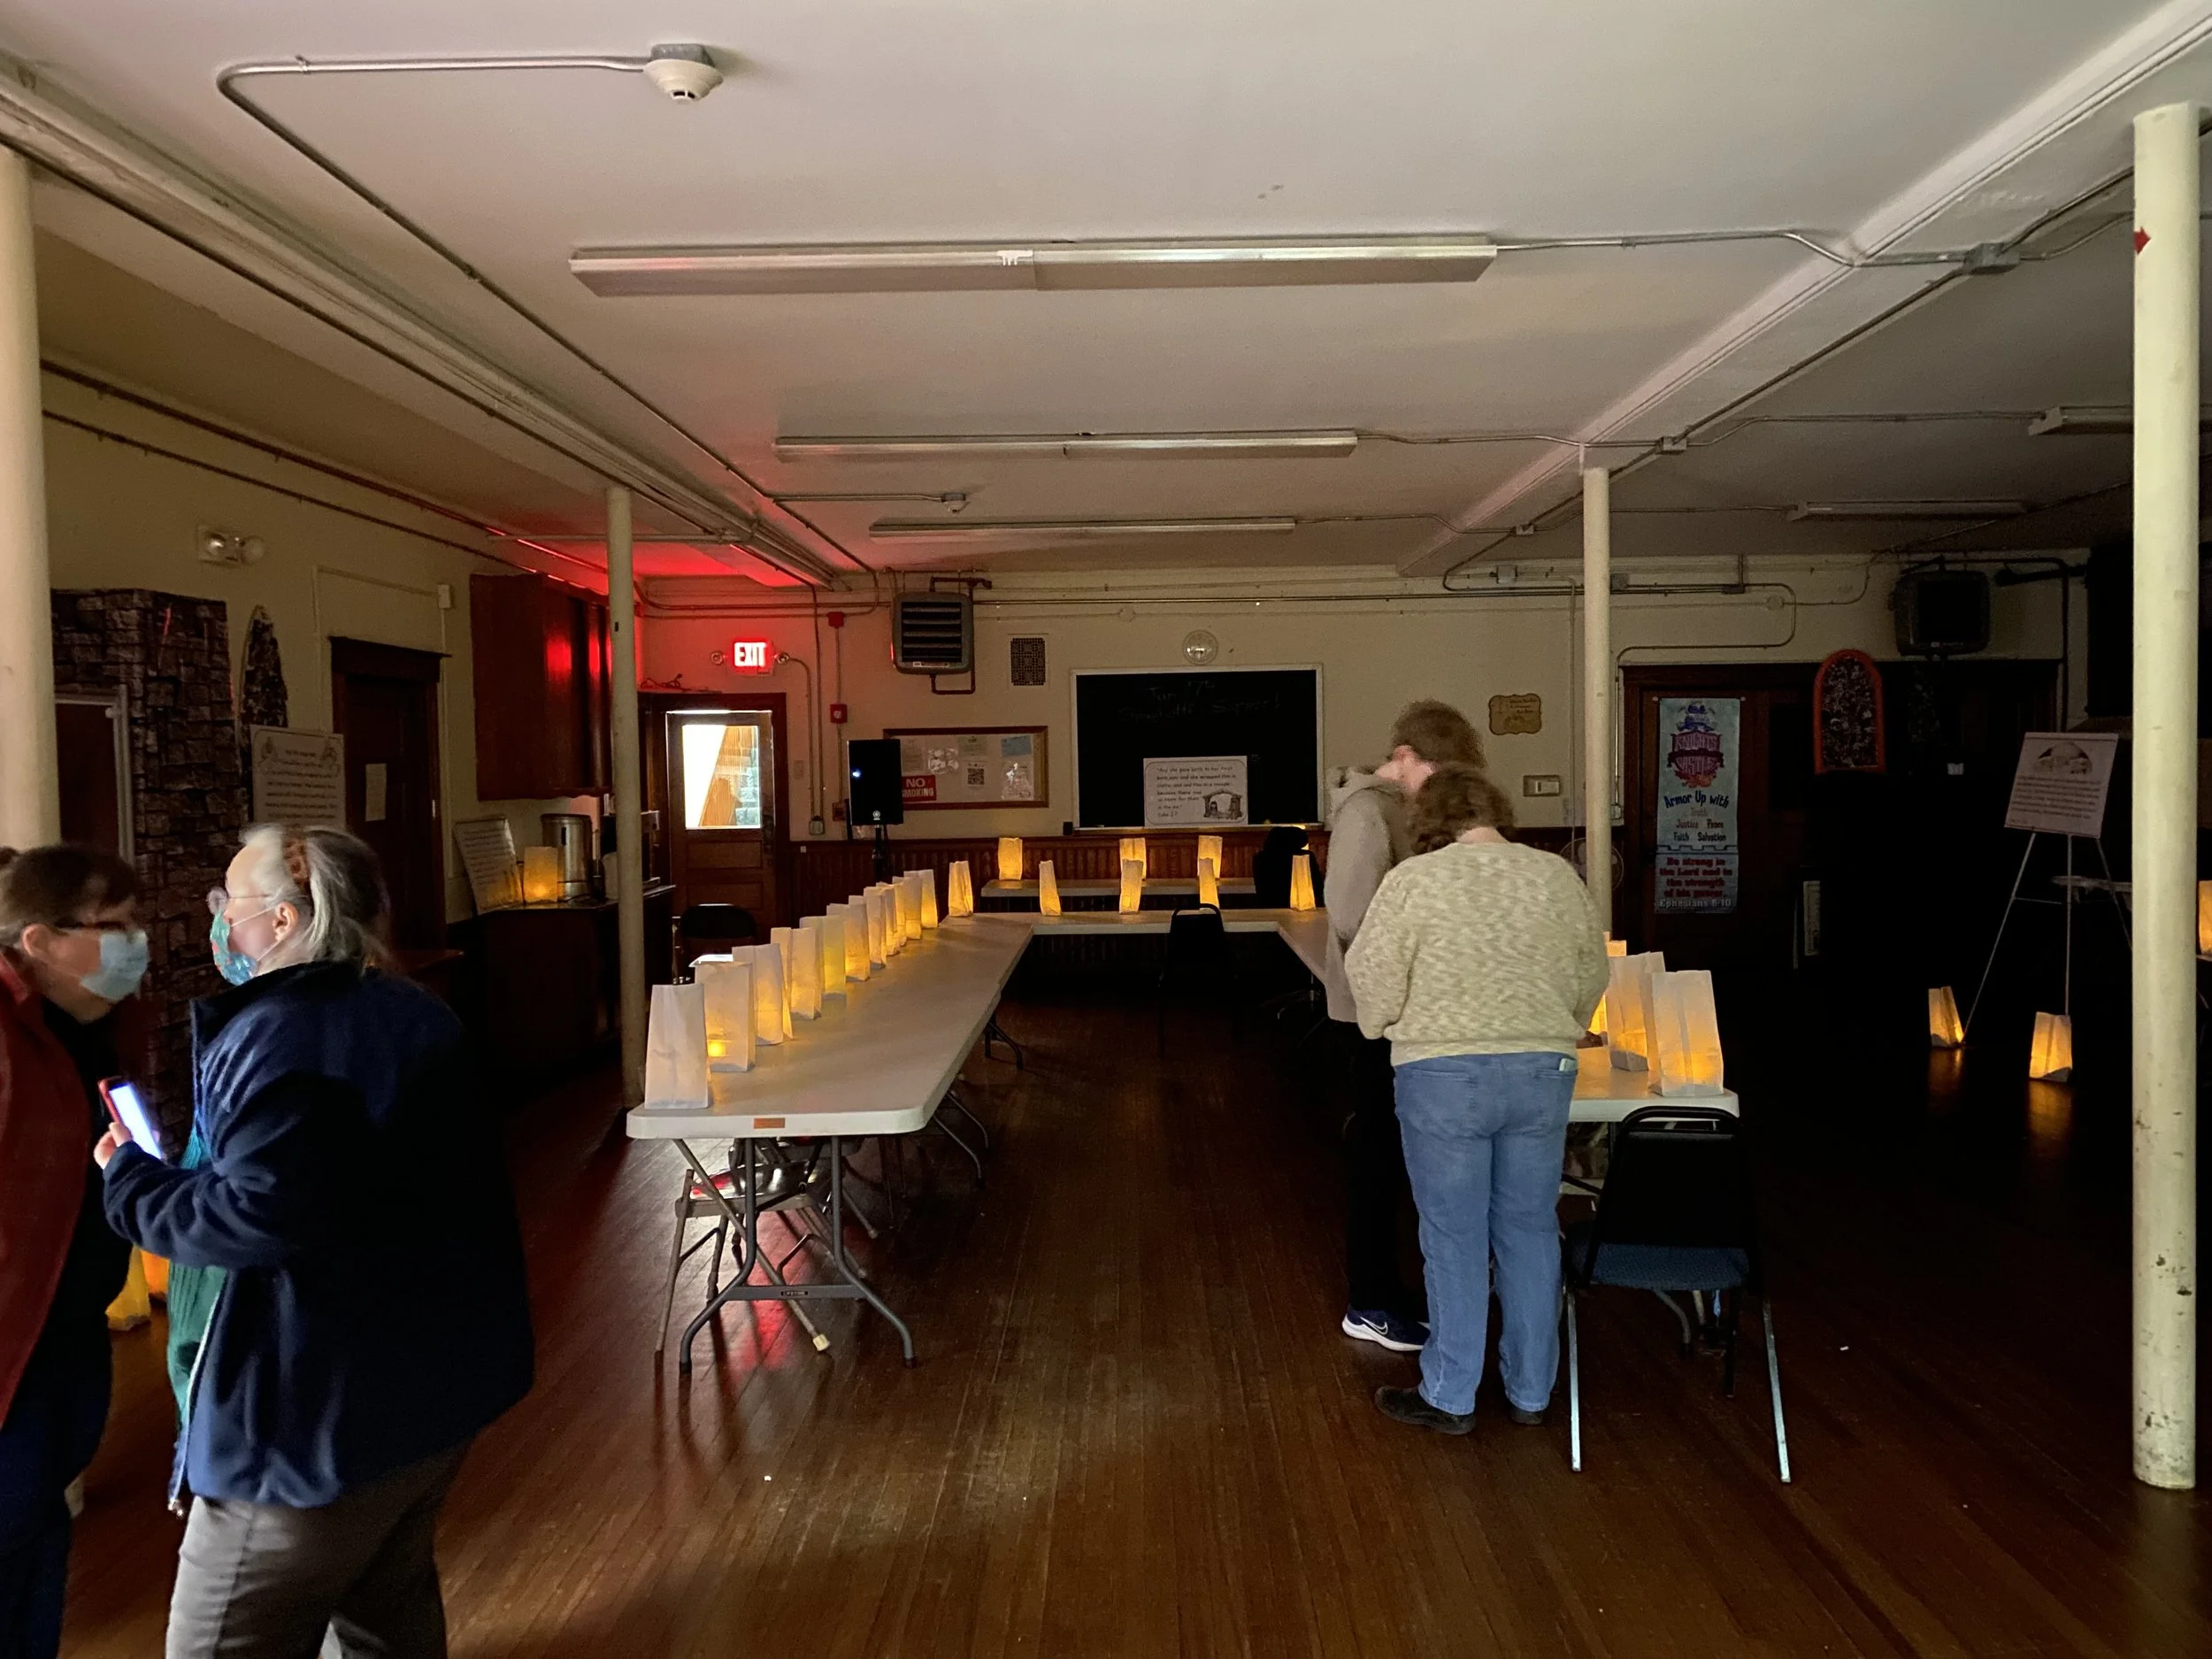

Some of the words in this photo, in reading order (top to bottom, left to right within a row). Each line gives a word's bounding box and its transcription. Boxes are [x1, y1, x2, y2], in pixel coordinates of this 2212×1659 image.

[734, 641, 767, 667] EXIT
[905, 777, 926, 788] NO
[1663, 794, 1692, 809] Armor
[1694, 789, 1706, 807] Up
[1709, 794, 1730, 809] with
[1676, 818, 1699, 829] Justice
[1673, 832, 1689, 841] Faith
[1697, 832, 1726, 841] Salvation
[1685, 878, 1724, 888] strength
[1659, 899, 1709, 909] Ephesians
